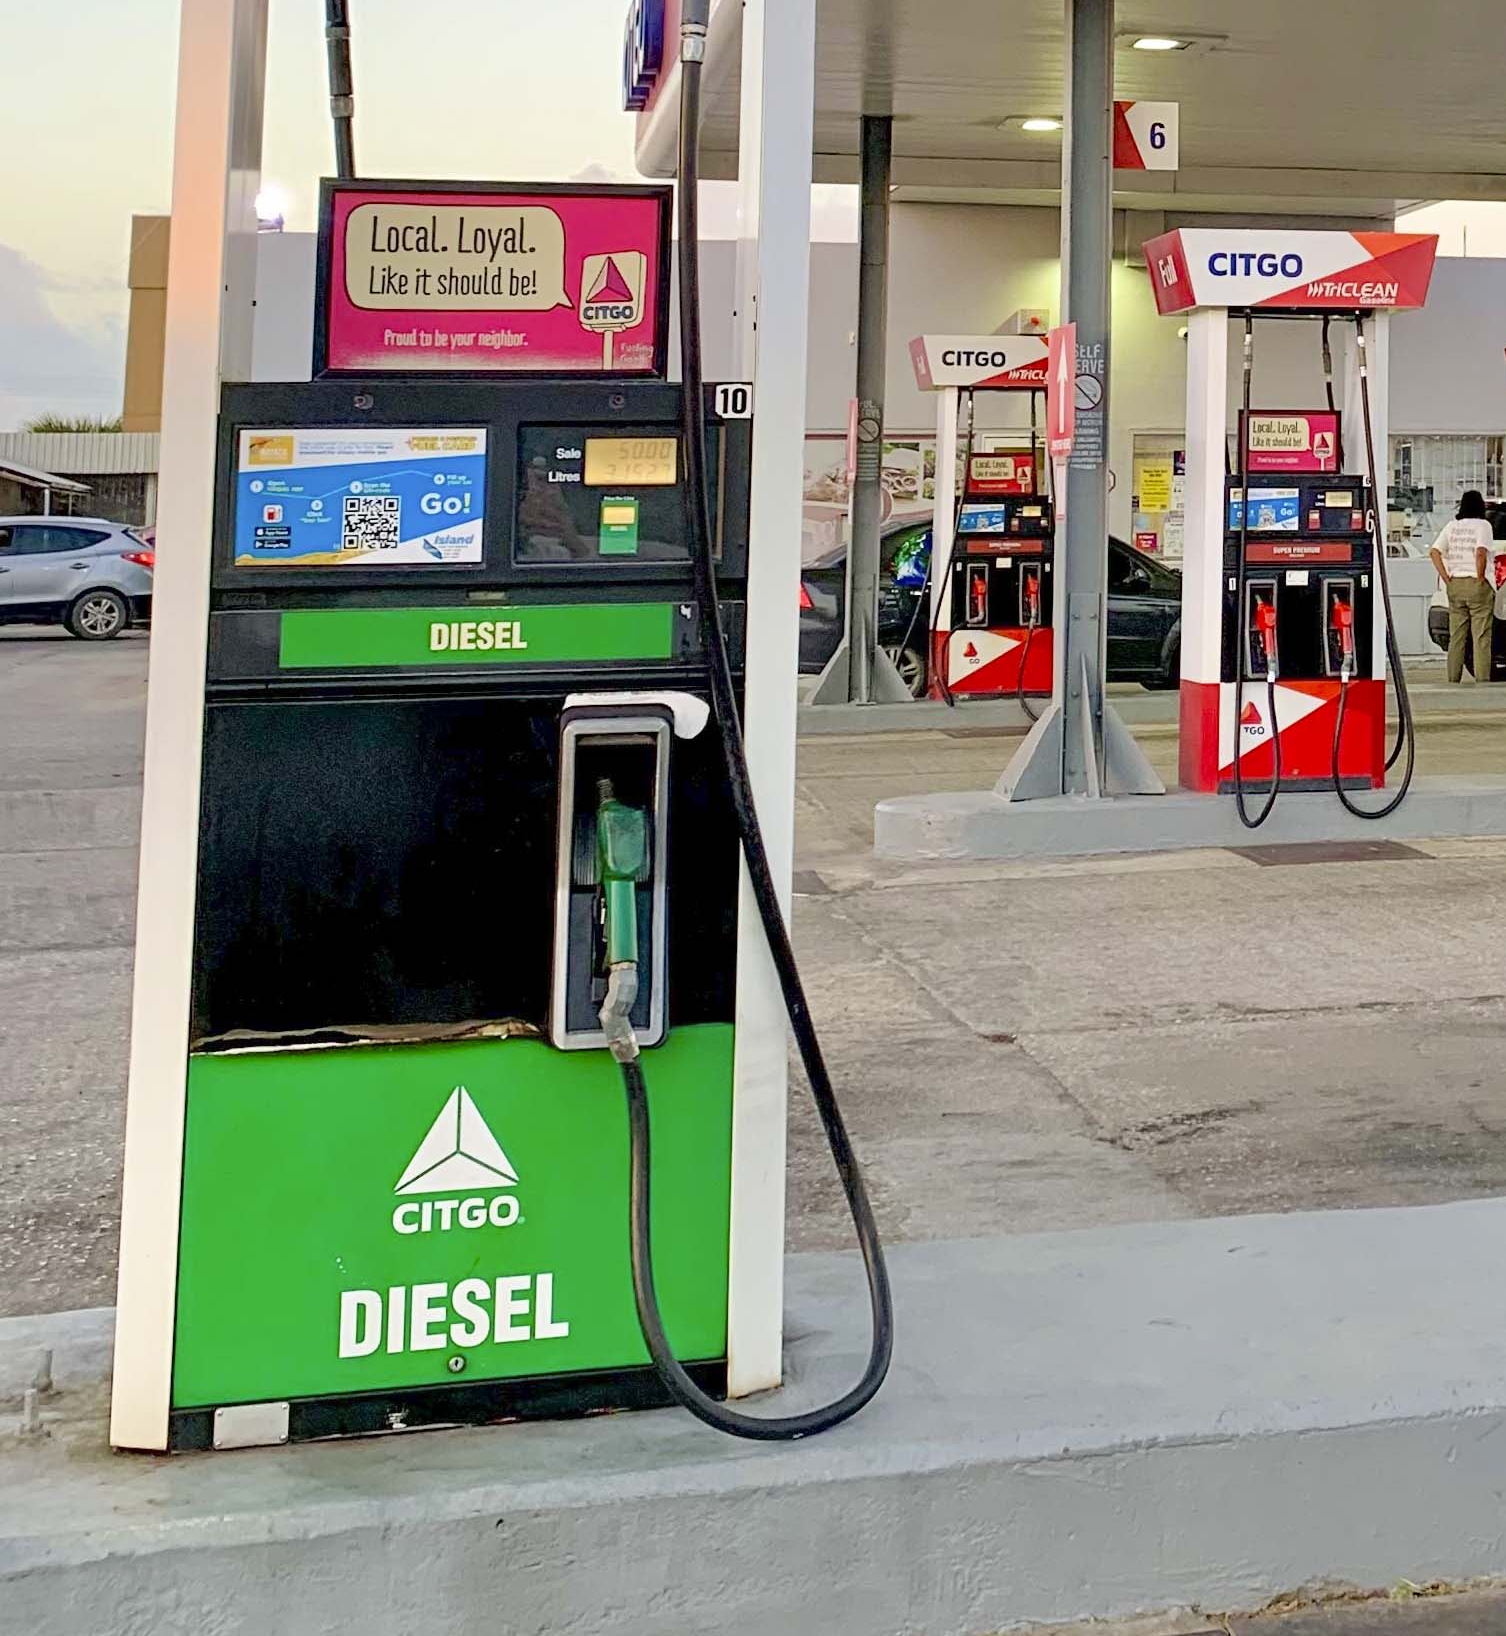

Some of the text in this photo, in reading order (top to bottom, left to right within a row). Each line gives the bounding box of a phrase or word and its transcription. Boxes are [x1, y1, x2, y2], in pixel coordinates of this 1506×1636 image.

[1150, 122, 1166, 150] 6
[371, 215, 537, 263] Local. Loyal.
[1158, 255, 1178, 289] Full
[1207, 252, 1303, 278] CITGO
[369, 265, 538, 297] Like it should be!
[583, 304, 635, 321] CITGO
[384, 328, 529, 351] Proud to be your neighbor.
[942, 350, 1007, 368] CITGO
[720, 387, 748, 414] 10
[555, 447, 582, 460] Sale
[547, 470, 581, 483] Litres
[420, 492, 472, 515] Go!
[1365, 508, 1376, 533] 6
[430, 620, 528, 652] DIESEL
[392, 1195, 521, 1235] CITGO
[338, 1272, 570, 1360] DIESEL
